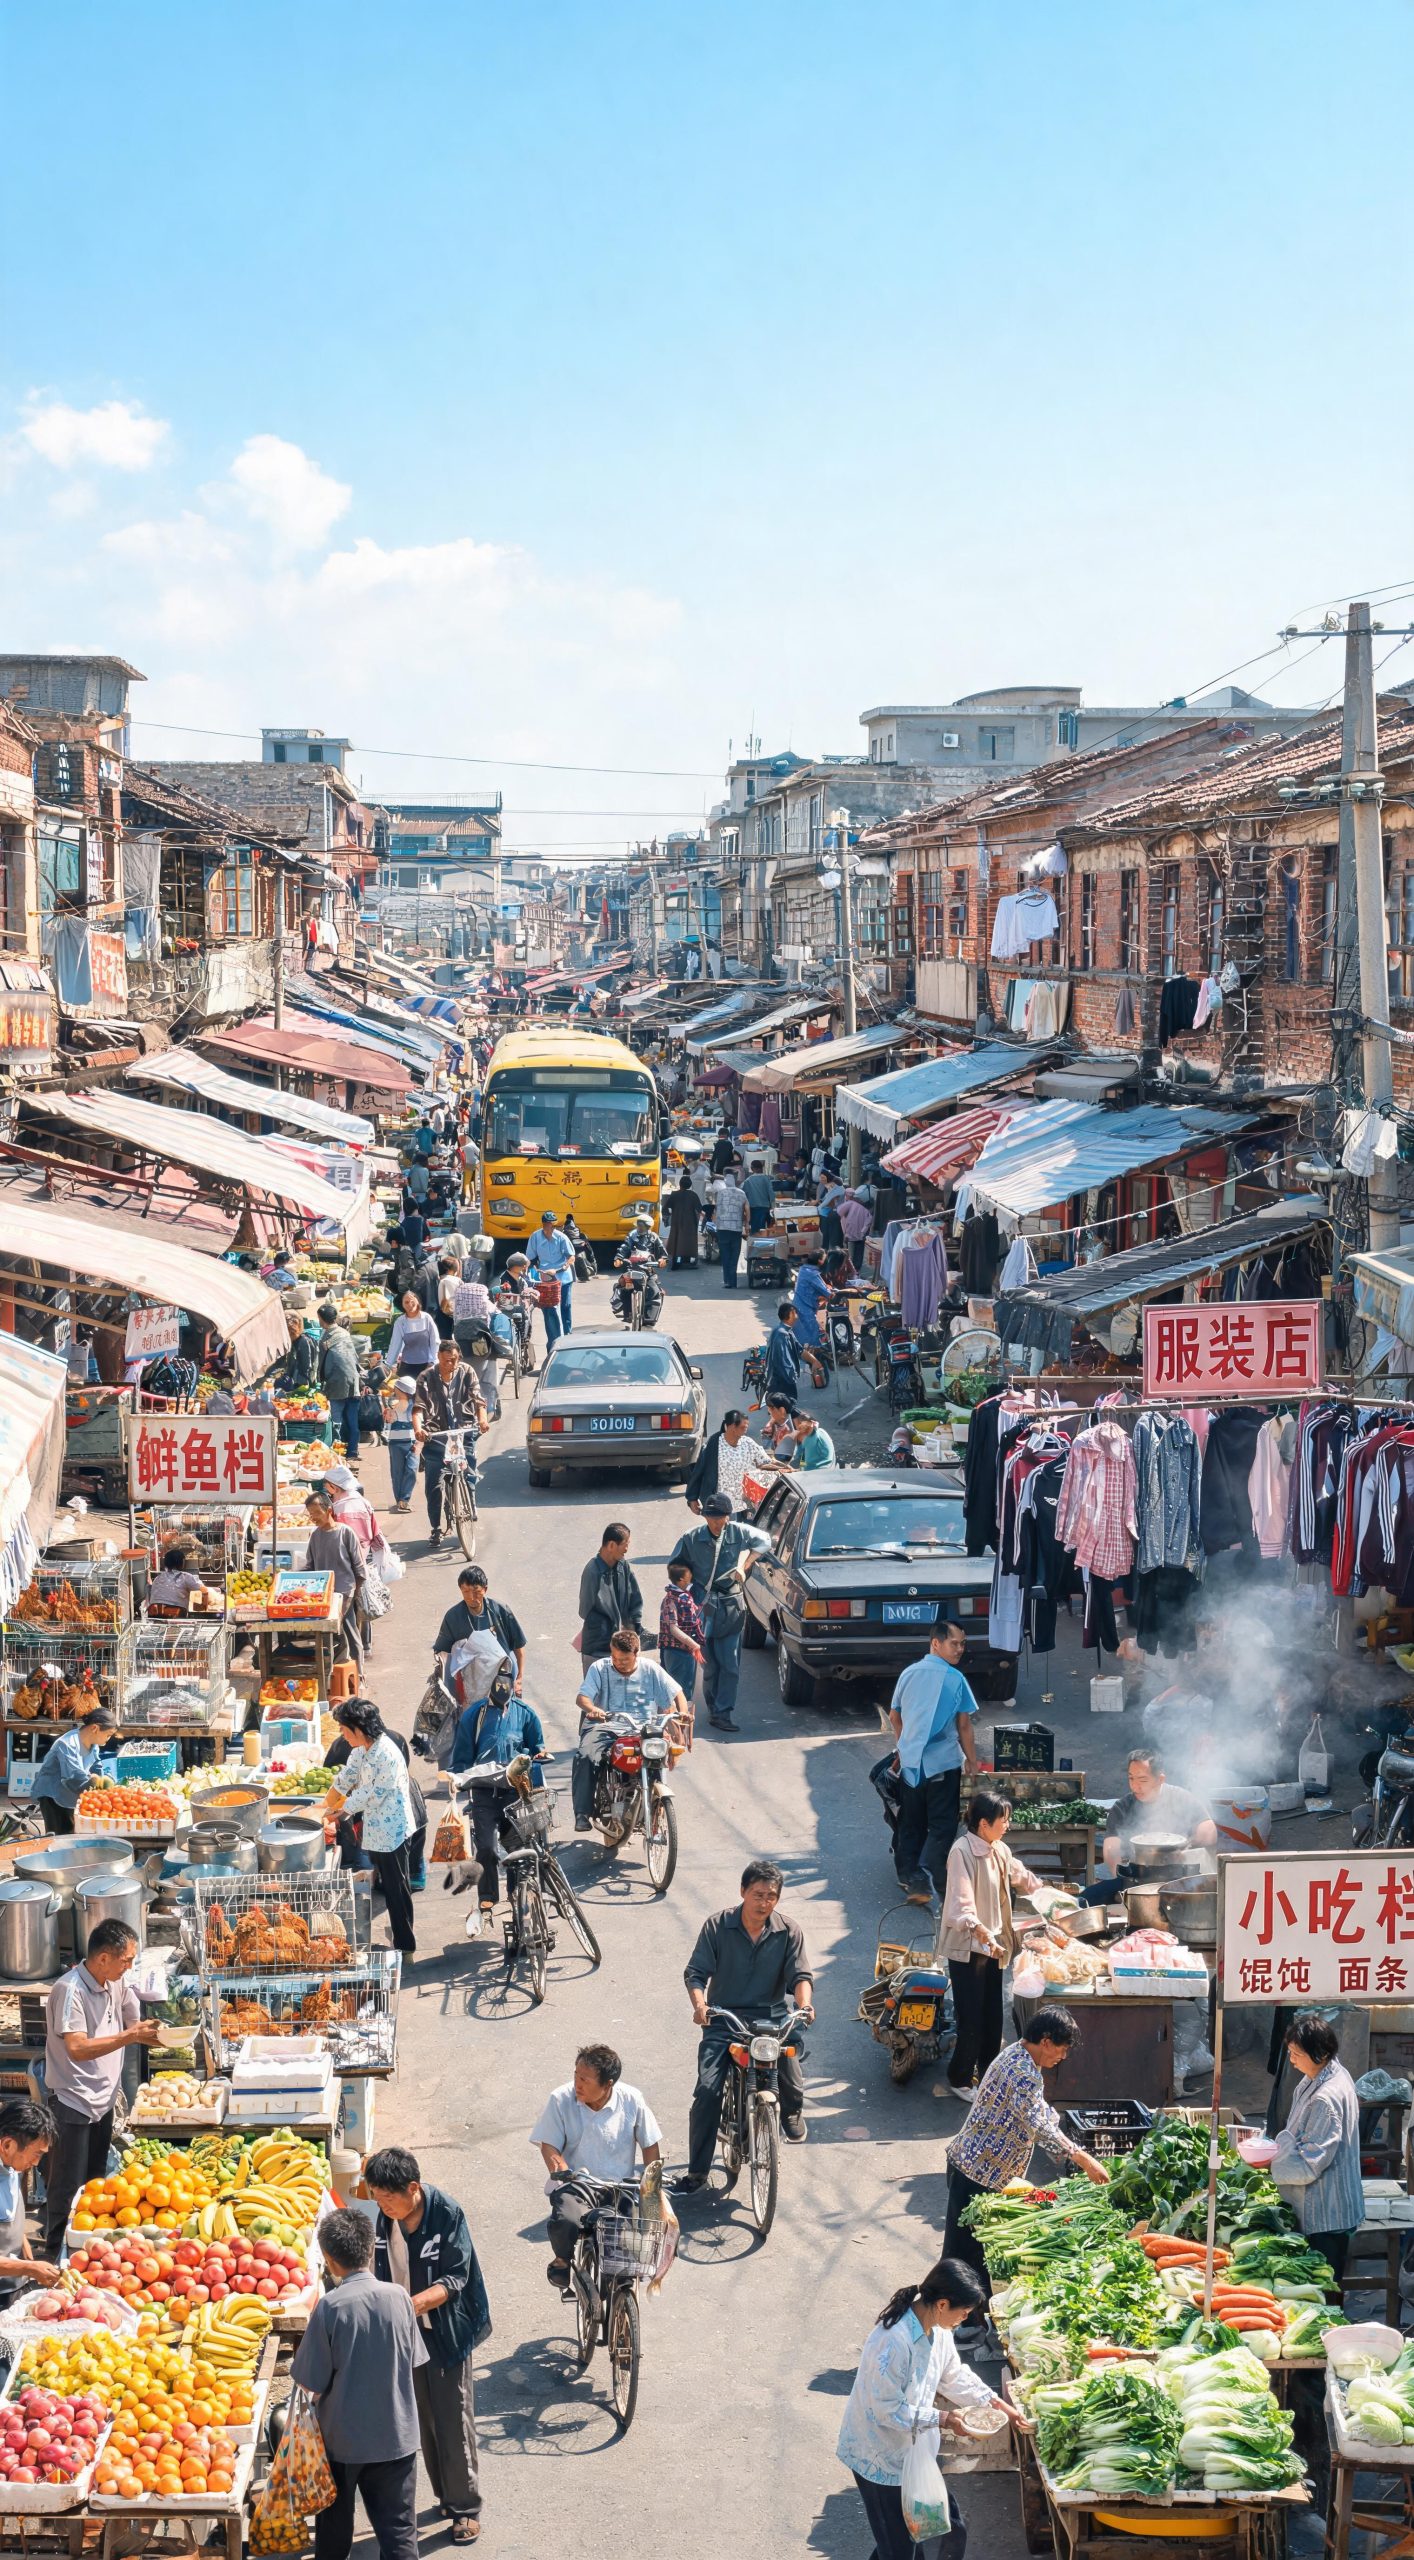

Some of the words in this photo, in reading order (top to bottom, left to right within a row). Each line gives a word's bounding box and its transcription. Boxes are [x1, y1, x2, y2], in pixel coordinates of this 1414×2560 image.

[1155, 1311, 1312, 1384] 服装店
[1239, 1957, 1312, 1993] 馄饨
[1338, 1955, 1408, 1993] 面条
